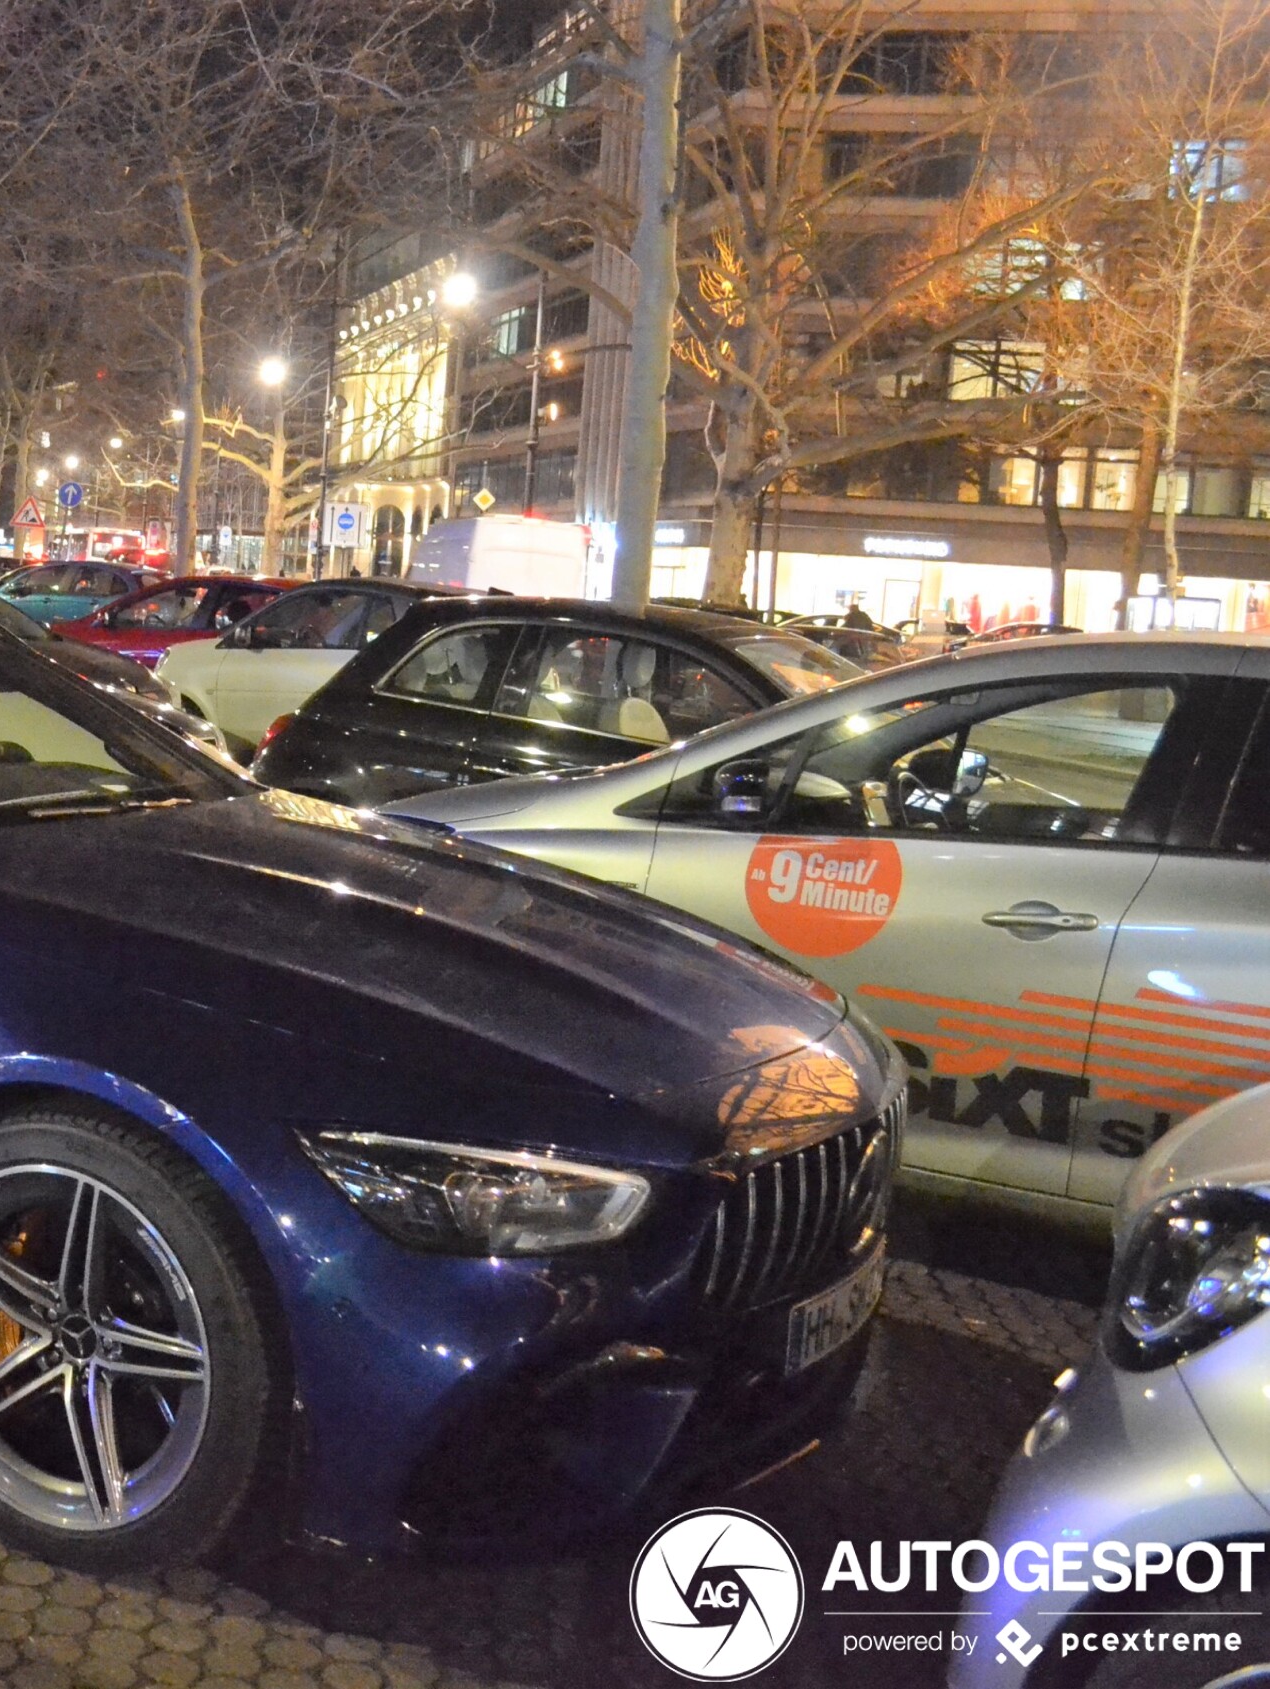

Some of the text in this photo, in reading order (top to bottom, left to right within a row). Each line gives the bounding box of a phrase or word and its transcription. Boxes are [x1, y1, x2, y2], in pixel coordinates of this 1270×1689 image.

[750, 849, 878, 904] Ab 9 Cent/
[799, 879, 891, 917] Minute
